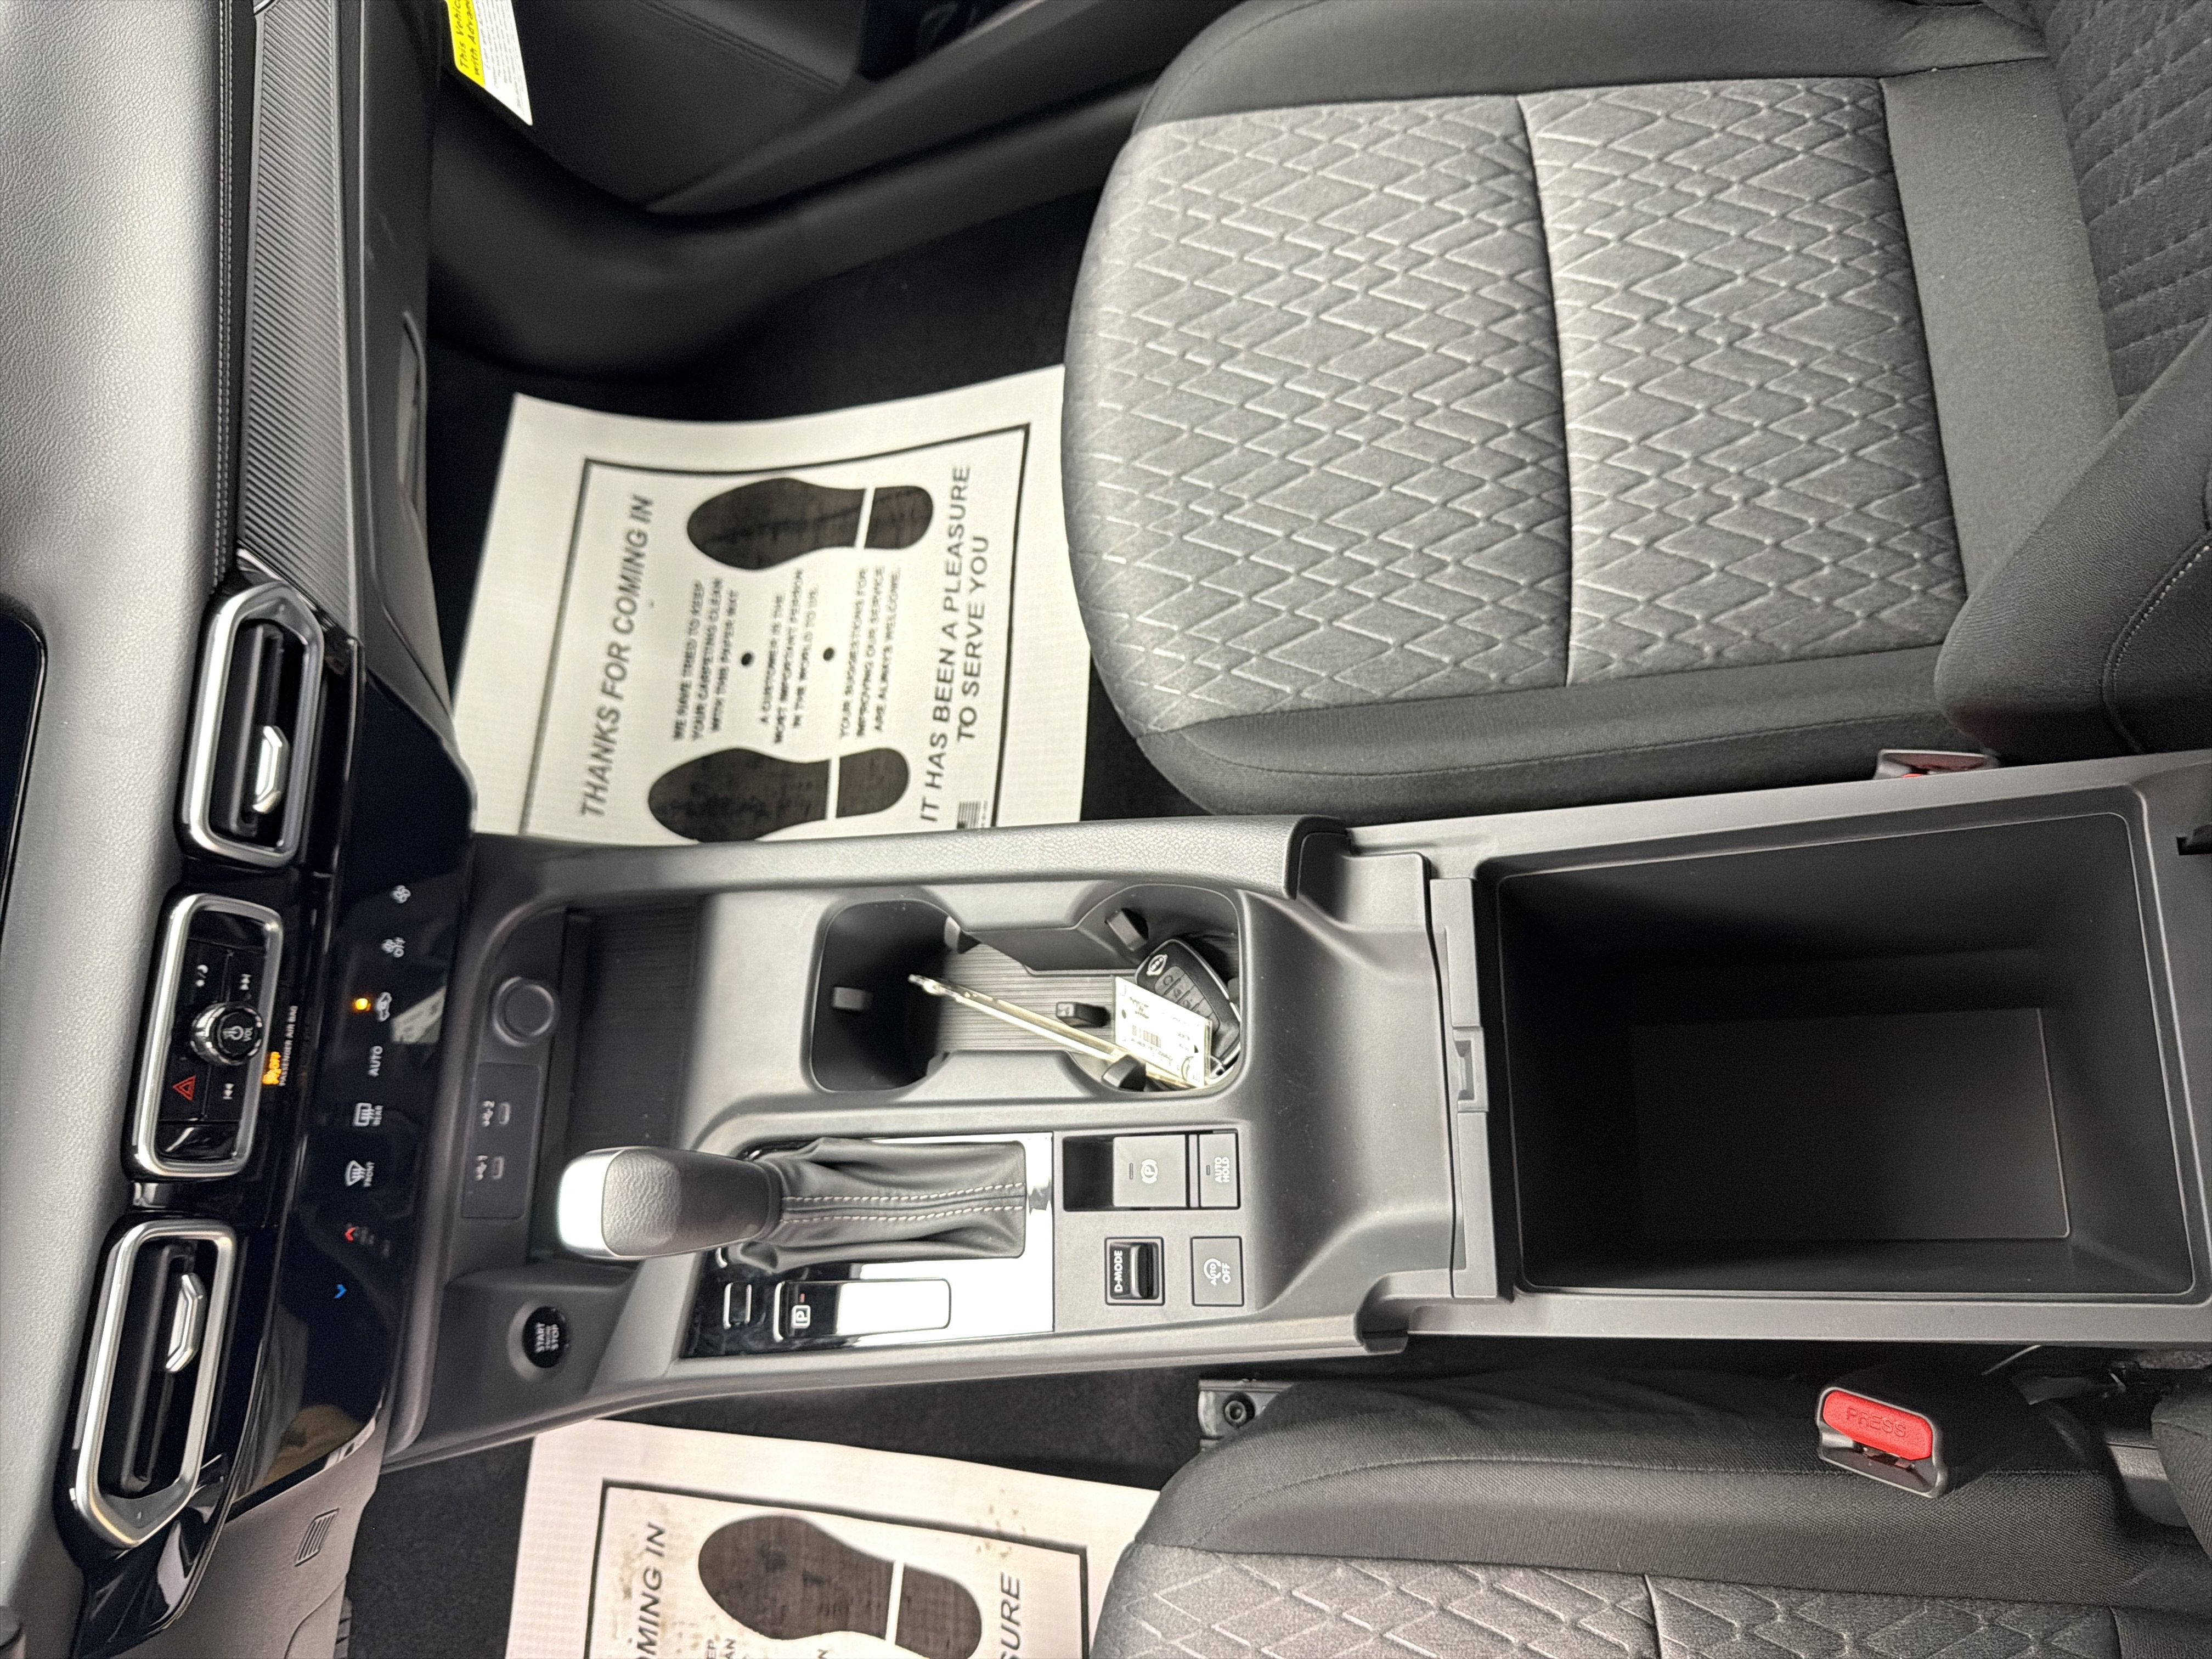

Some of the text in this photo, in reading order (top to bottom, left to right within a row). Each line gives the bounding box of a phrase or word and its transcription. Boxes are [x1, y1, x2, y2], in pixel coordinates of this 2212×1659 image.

[459, 41, 469, 68] This
[470, 47, 479, 76] with
[688, 618, 701, 636] TO
[805, 611, 816, 628] TO
[839, 699, 853, 738] YOUR
[856, 567, 868, 596] FOR
[866, 628, 878, 658] OUR
[920, 466, 970, 822] IT HAS BEEN A PLEASURE
[957, 536, 988, 742] TO SERVE YOU
[579, 494, 653, 817] THANKS FOR COMING IN
[691, 703, 706, 741] YOUR
[393, 936, 406, 958] OFF
[243, 1027, 253, 1041] VOL
[285, 1024, 296, 1039] AIR
[368, 1046, 383, 1077] AUTO
[363, 1161, 375, 1187] FRONT
[1214, 1157, 1222, 1183] AUTO
[1222, 1157, 1230, 1182] HOLD
[1114, 1250, 1123, 1293] D-MODE
[1222, 1262, 1231, 1284] OFF
[534, 1322, 545, 1352] START
[551, 1324, 560, 1351] STOP
[1846, 1407, 1906, 1437] PRESS
[637, 1522, 665, 1659] MING IN
